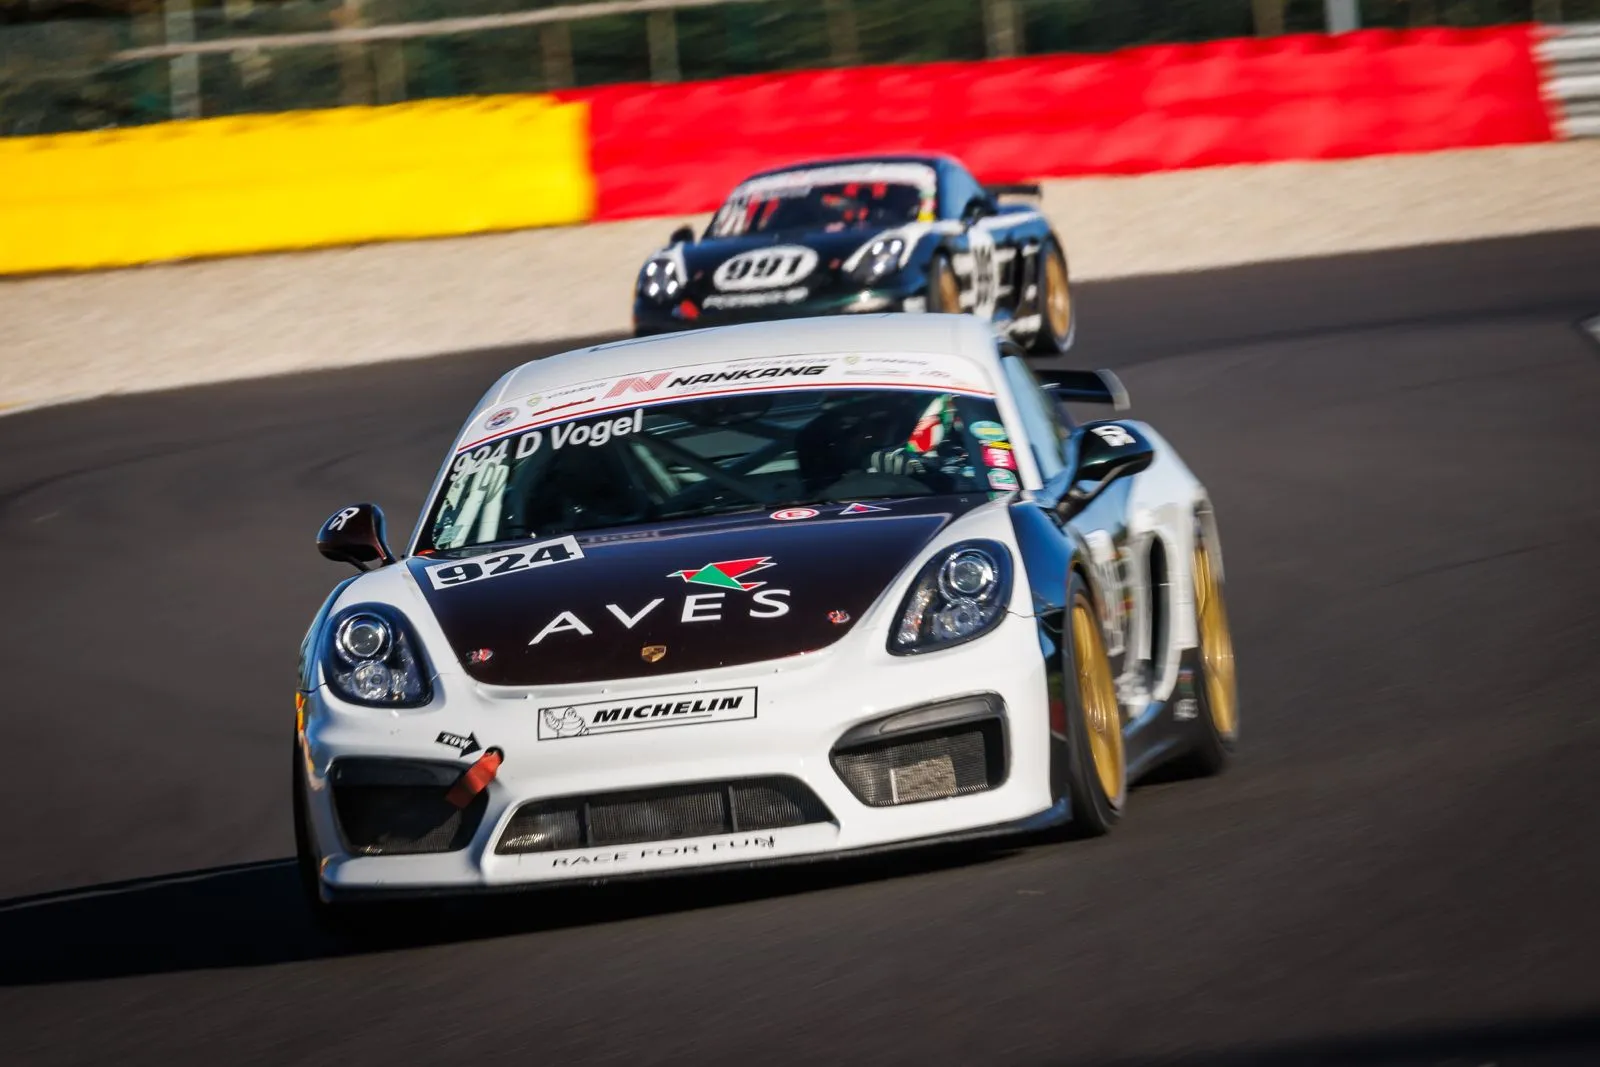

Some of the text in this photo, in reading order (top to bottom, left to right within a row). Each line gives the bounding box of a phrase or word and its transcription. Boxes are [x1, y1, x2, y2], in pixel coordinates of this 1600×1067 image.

[724, 255, 804, 281] 991
[667, 365, 828, 388] NANKANG
[450, 408, 643, 482] 924 D Vogel
[436, 543, 577, 586] 924
[528, 589, 791, 646] AVES
[593, 696, 743, 723] MICHELIN
[442, 733, 473, 750] TOW
[552, 835, 775, 867] RACE FOR FUN
